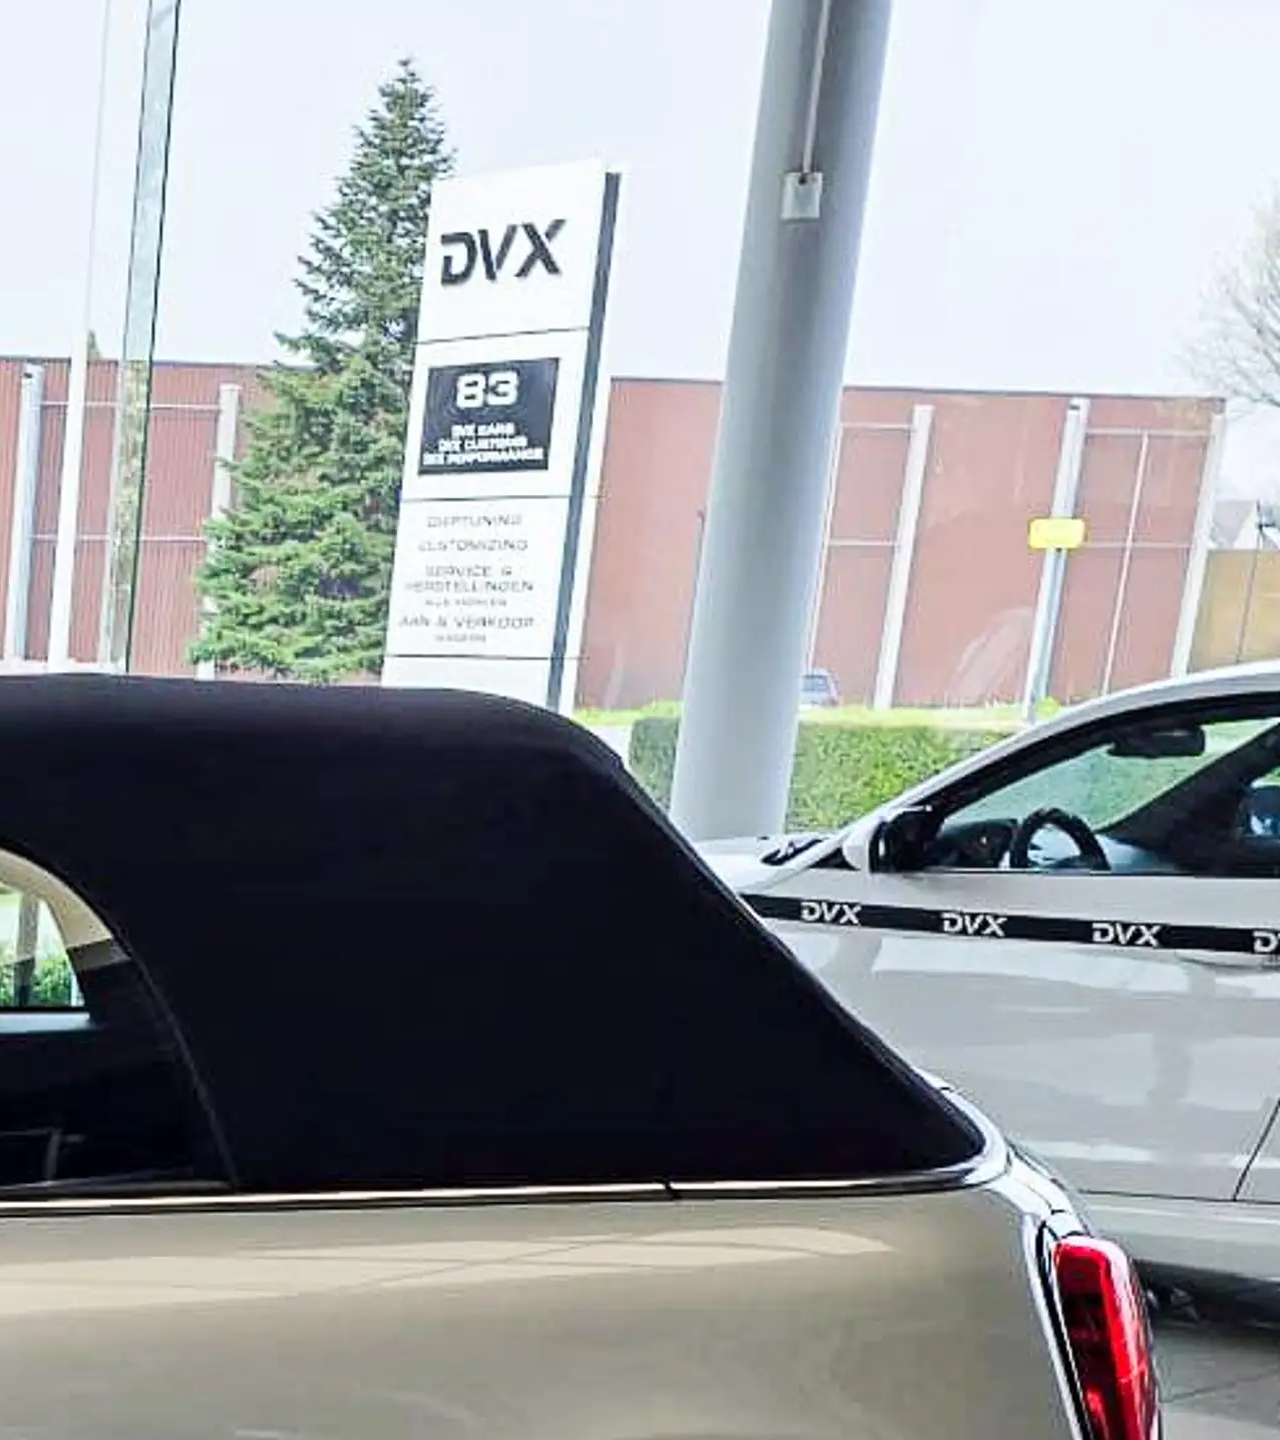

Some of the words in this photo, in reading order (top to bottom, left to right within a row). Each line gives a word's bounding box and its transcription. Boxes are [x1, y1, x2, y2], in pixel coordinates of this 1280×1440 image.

[440, 217, 567, 286] DVX
[800, 901, 862, 926] DVX
[942, 911, 1008, 938] DVX
[1091, 922, 1161, 948] DVX
[1252, 930, 1280, 953] D
